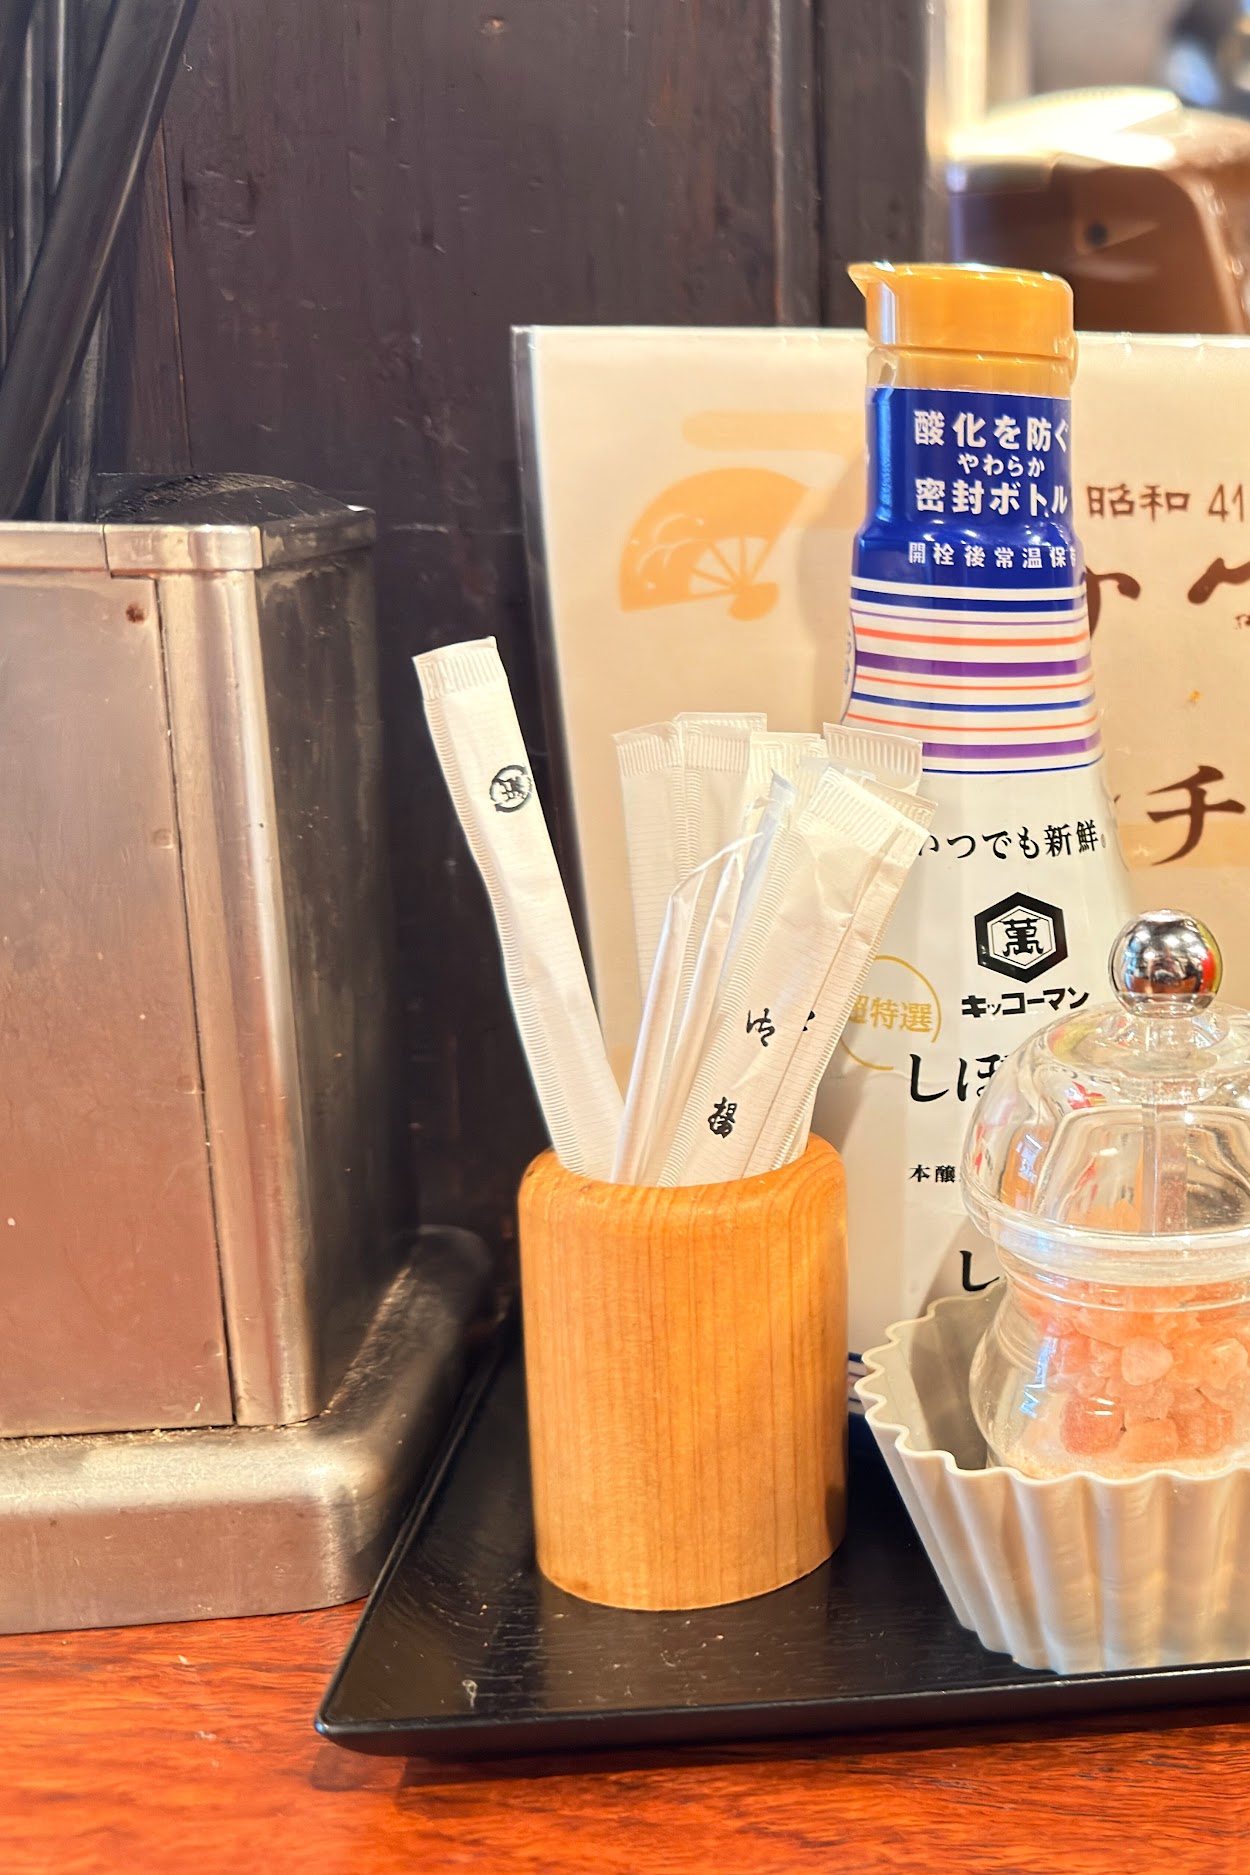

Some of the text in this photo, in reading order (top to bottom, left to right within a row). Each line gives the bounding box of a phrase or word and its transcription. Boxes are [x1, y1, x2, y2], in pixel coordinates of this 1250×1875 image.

[913, 410, 1070, 452] 酸化を防ぐ
[957, 453, 1046, 478] やわらか
[914, 477, 1068, 517] 密封ボトル
[961, 987, 1089, 1018] キッコーマン
